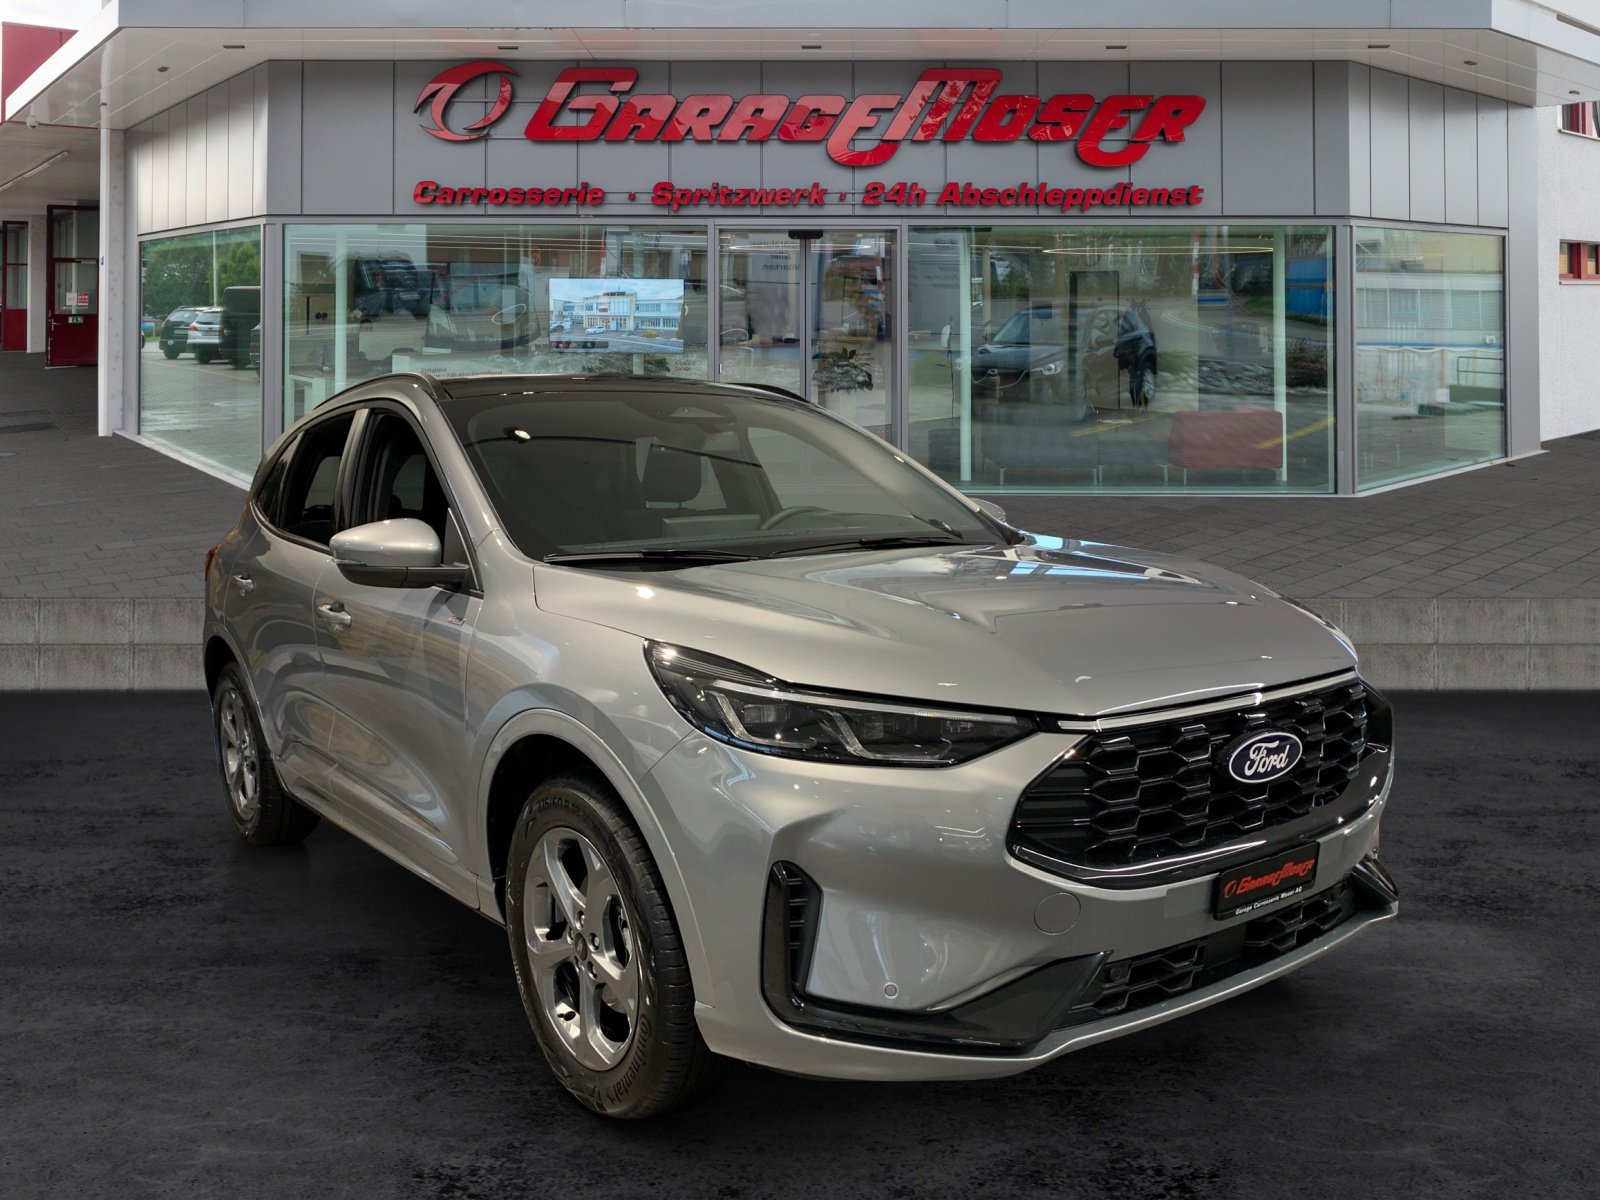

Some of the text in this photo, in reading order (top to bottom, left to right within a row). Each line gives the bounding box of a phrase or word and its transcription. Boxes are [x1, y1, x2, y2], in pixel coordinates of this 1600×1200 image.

[413, 181, 1204, 213] Carrosserie Spritzwerk 24h Abschleppdienst
[1244, 740, 1290, 777] Ford
[612, 1012, 652, 1104] Continental
